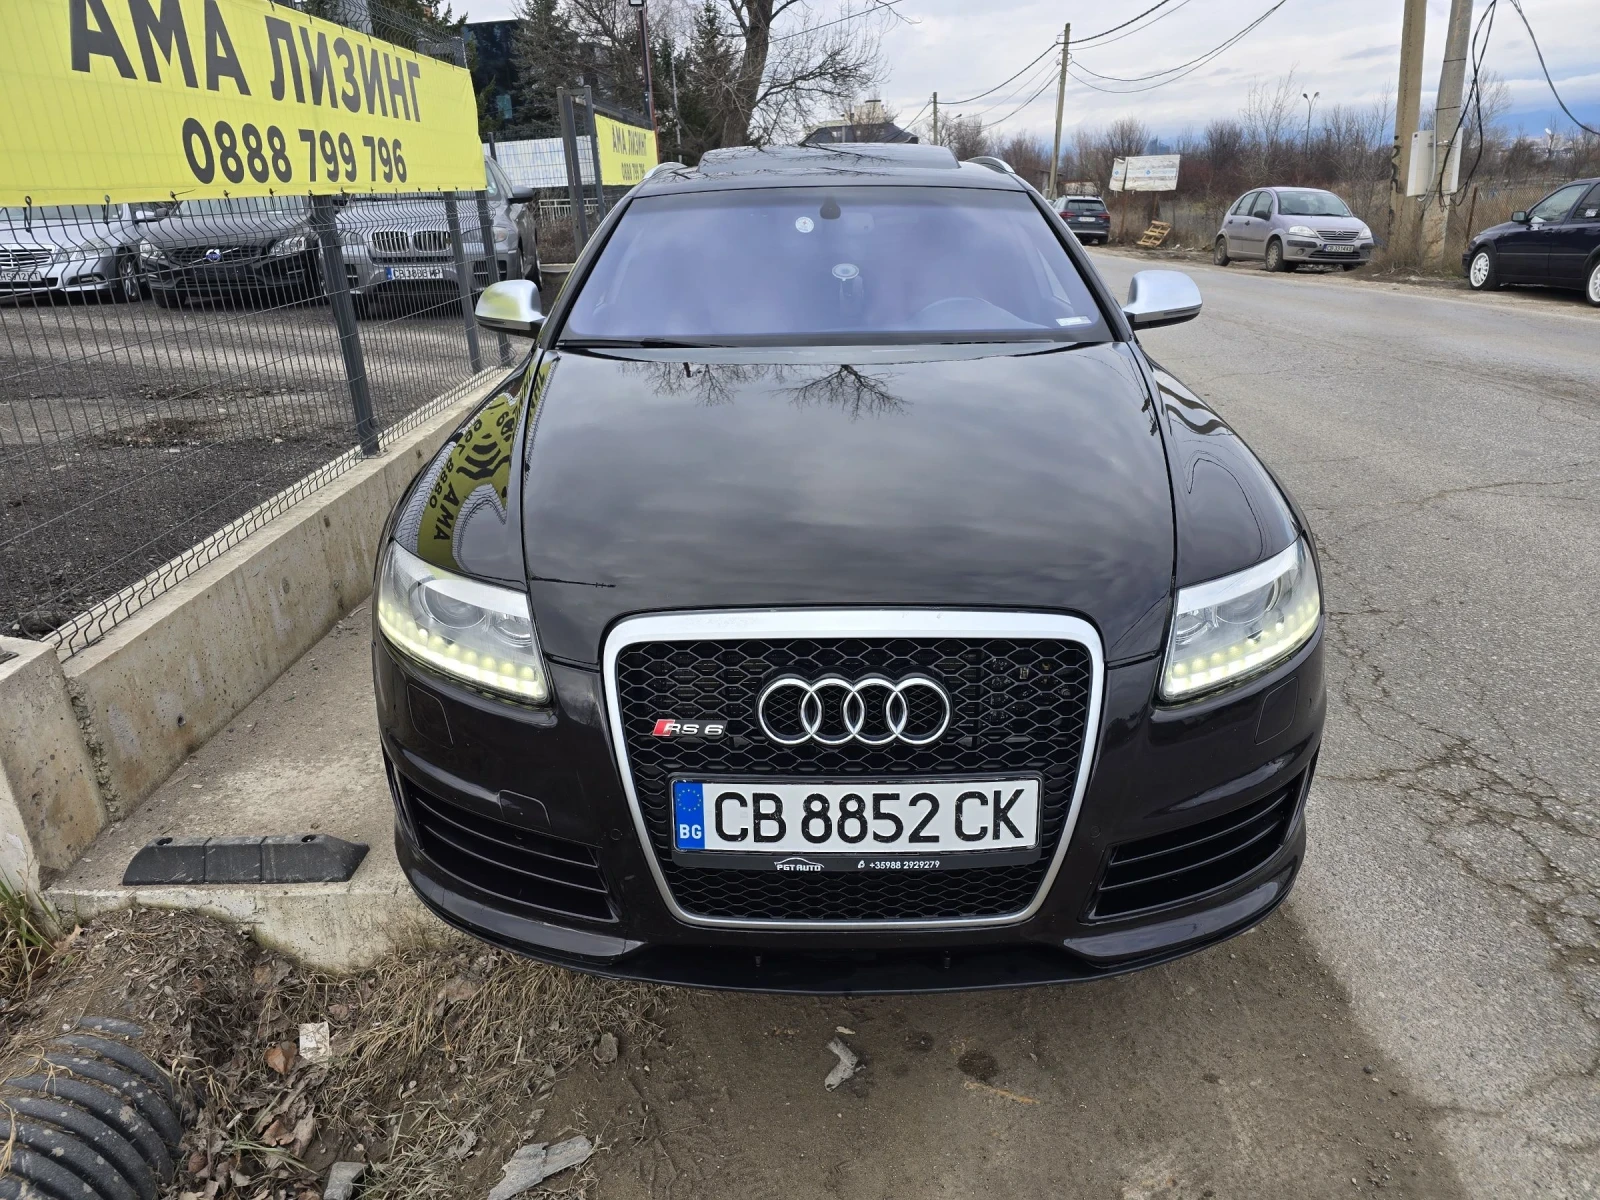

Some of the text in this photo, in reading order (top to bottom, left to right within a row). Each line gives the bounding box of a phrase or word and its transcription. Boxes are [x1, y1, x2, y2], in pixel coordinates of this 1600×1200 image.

[70, 0, 421, 123] АМА ЛИЗИНГ
[182, 117, 407, 184] 0888 799 796
[662, 723, 724, 736] RS 6
[714, 788, 1025, 844] CB 8852 CK
[679, 824, 702, 839] BG
[797, 864, 821, 872] AUTO
[869, 860, 940, 870] +35988 2929279
